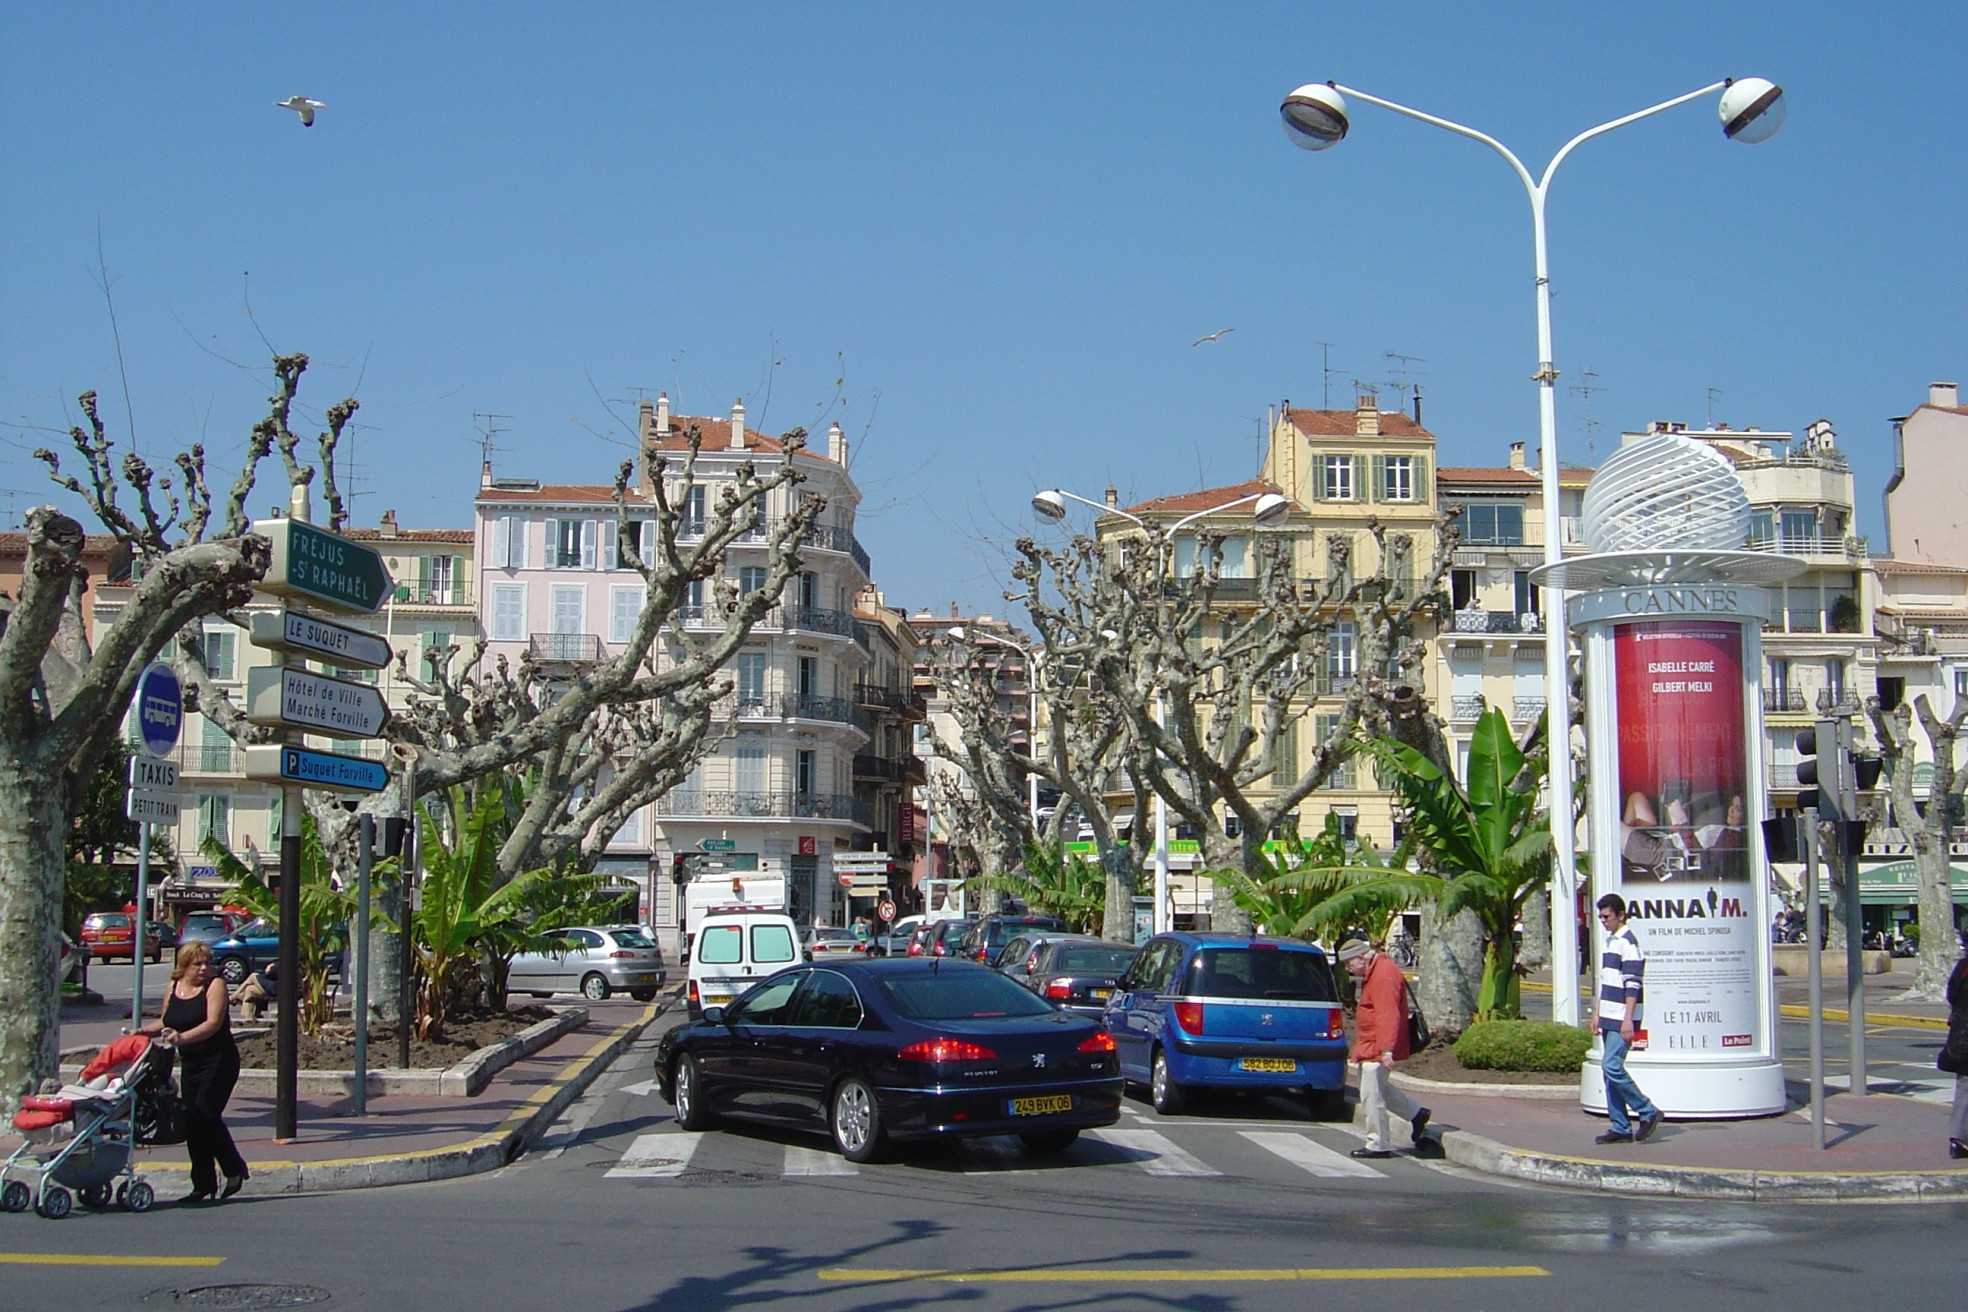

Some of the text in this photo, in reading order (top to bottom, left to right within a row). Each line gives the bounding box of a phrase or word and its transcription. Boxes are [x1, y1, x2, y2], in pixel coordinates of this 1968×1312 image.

[293, 532, 344, 566] FRÉJUS
[313, 565, 368, 600] RAPHAËL
[1626, 590, 1737, 614] CANNES
[290, 620, 349, 650] LE SUQUET
[1648, 660, 1715, 673] ISABELLE CARRÉ
[288, 677, 362, 707] Hôtel de Ville
[1652, 682, 1713, 693] GILBERT MELKI
[287, 698, 369, 728] Marché Forville
[141, 763, 174, 786] TAXIS
[301, 758, 335, 779] Suquet
[339, 764, 373, 783] Forville
[134, 799, 177, 816] PETIT TRAIN
[1626, 898, 1748, 919] ANNA M.
[1648, 928, 1658, 936] UN
[1658, 928, 1672, 936] FILM
[1684, 927, 1706, 936] MICHEL
[1708, 927, 1731, 935] SPINOSA
[1664, 1011, 1722, 1023] LE 11 AVRIL
[1669, 1035, 1709, 1049] ELLE
[1244, 1058, 1261, 1069] 582
[1015, 1096, 1070, 1113] 249 BVK 06
